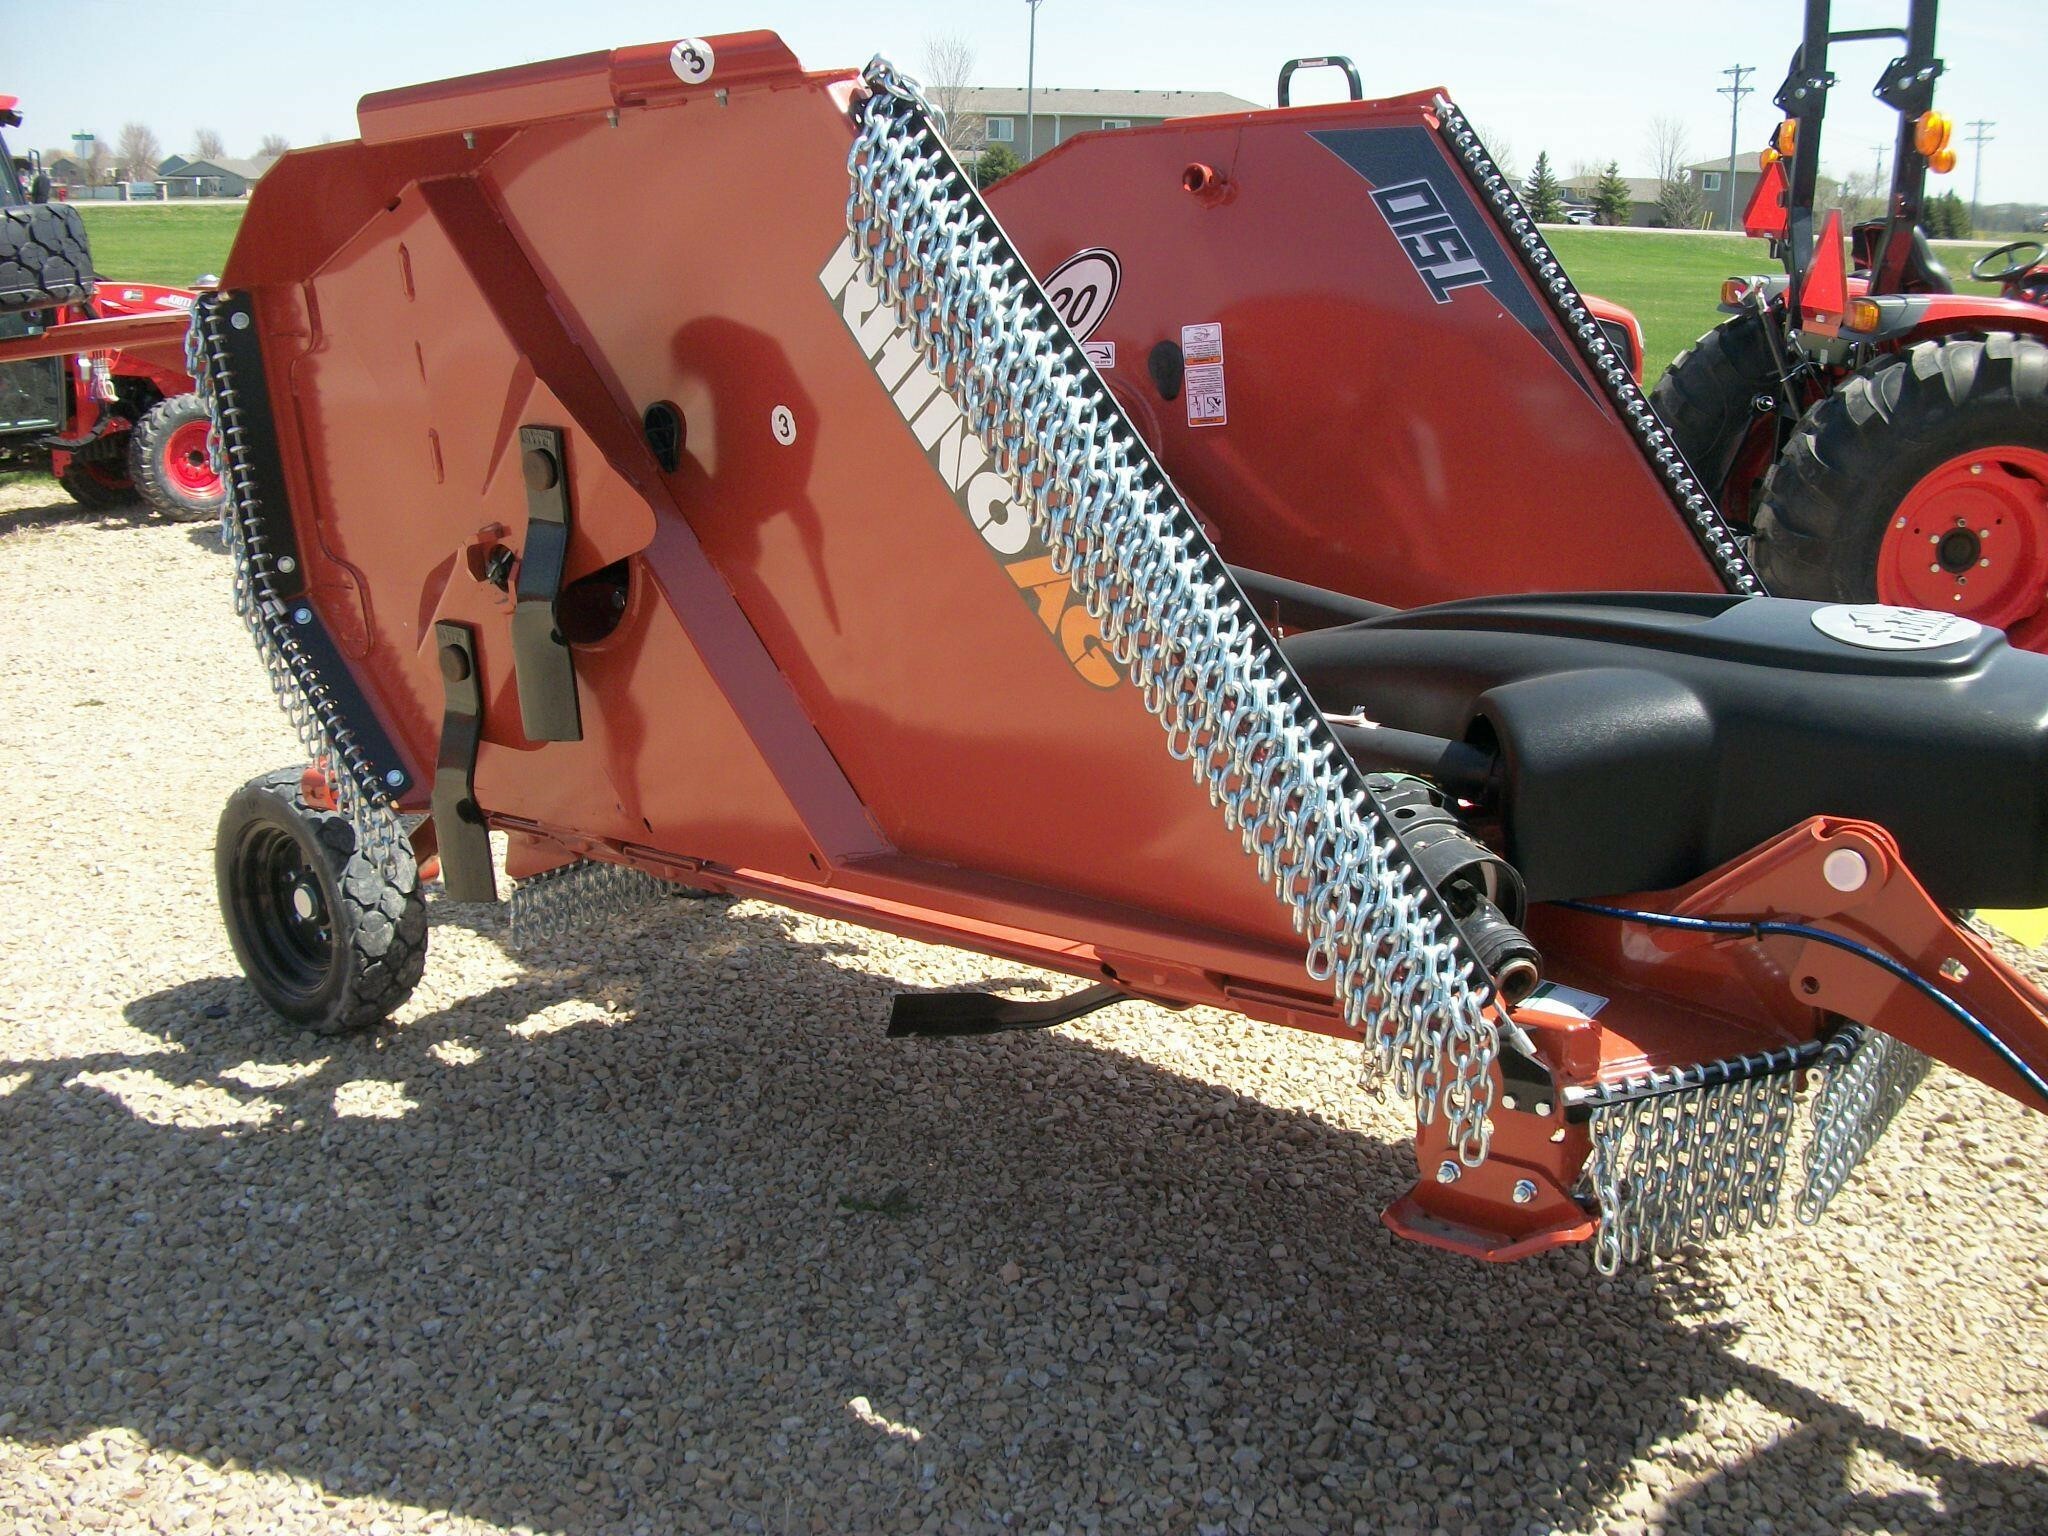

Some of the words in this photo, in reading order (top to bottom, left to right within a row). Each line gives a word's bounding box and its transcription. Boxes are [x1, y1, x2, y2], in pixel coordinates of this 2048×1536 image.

[680, 46, 705, 75] 3
[777, 412, 790, 439] 3
[818, 236, 1031, 555] RHINO
[1004, 554, 1122, 688] AG
